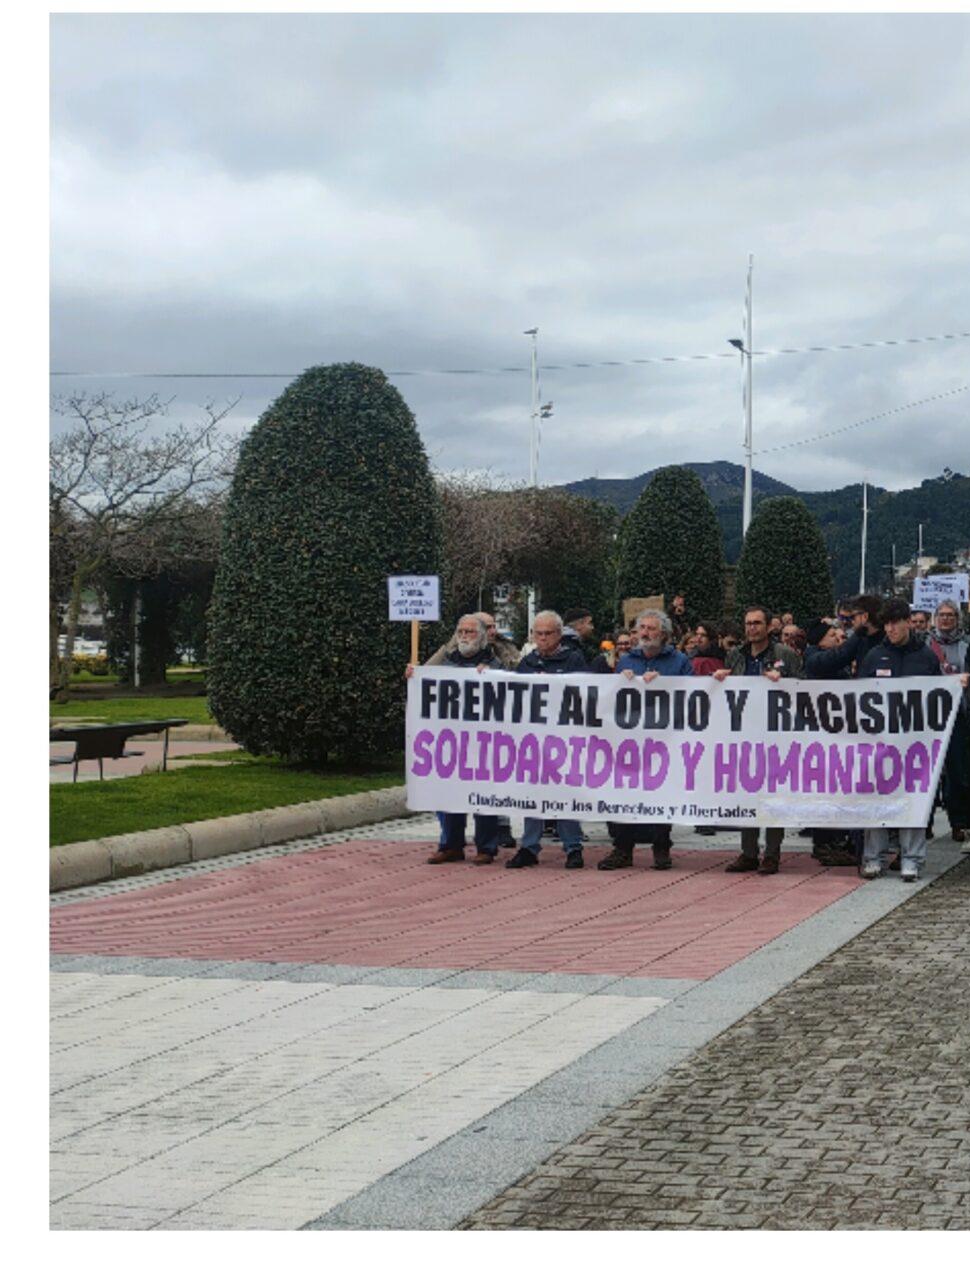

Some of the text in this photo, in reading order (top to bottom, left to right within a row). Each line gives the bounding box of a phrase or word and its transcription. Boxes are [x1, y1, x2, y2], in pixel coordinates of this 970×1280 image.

[420, 677, 953, 734] FRENTE AL ODIO Y RACISMO
[411, 728, 670, 792] SOLIDARIDAD
[680, 740, 706, 792] Y
[540, 799, 568, 814] por
[570, 797, 594, 813] los
[596, 798, 665, 817] Derechos
[667, 804, 678, 820] y
